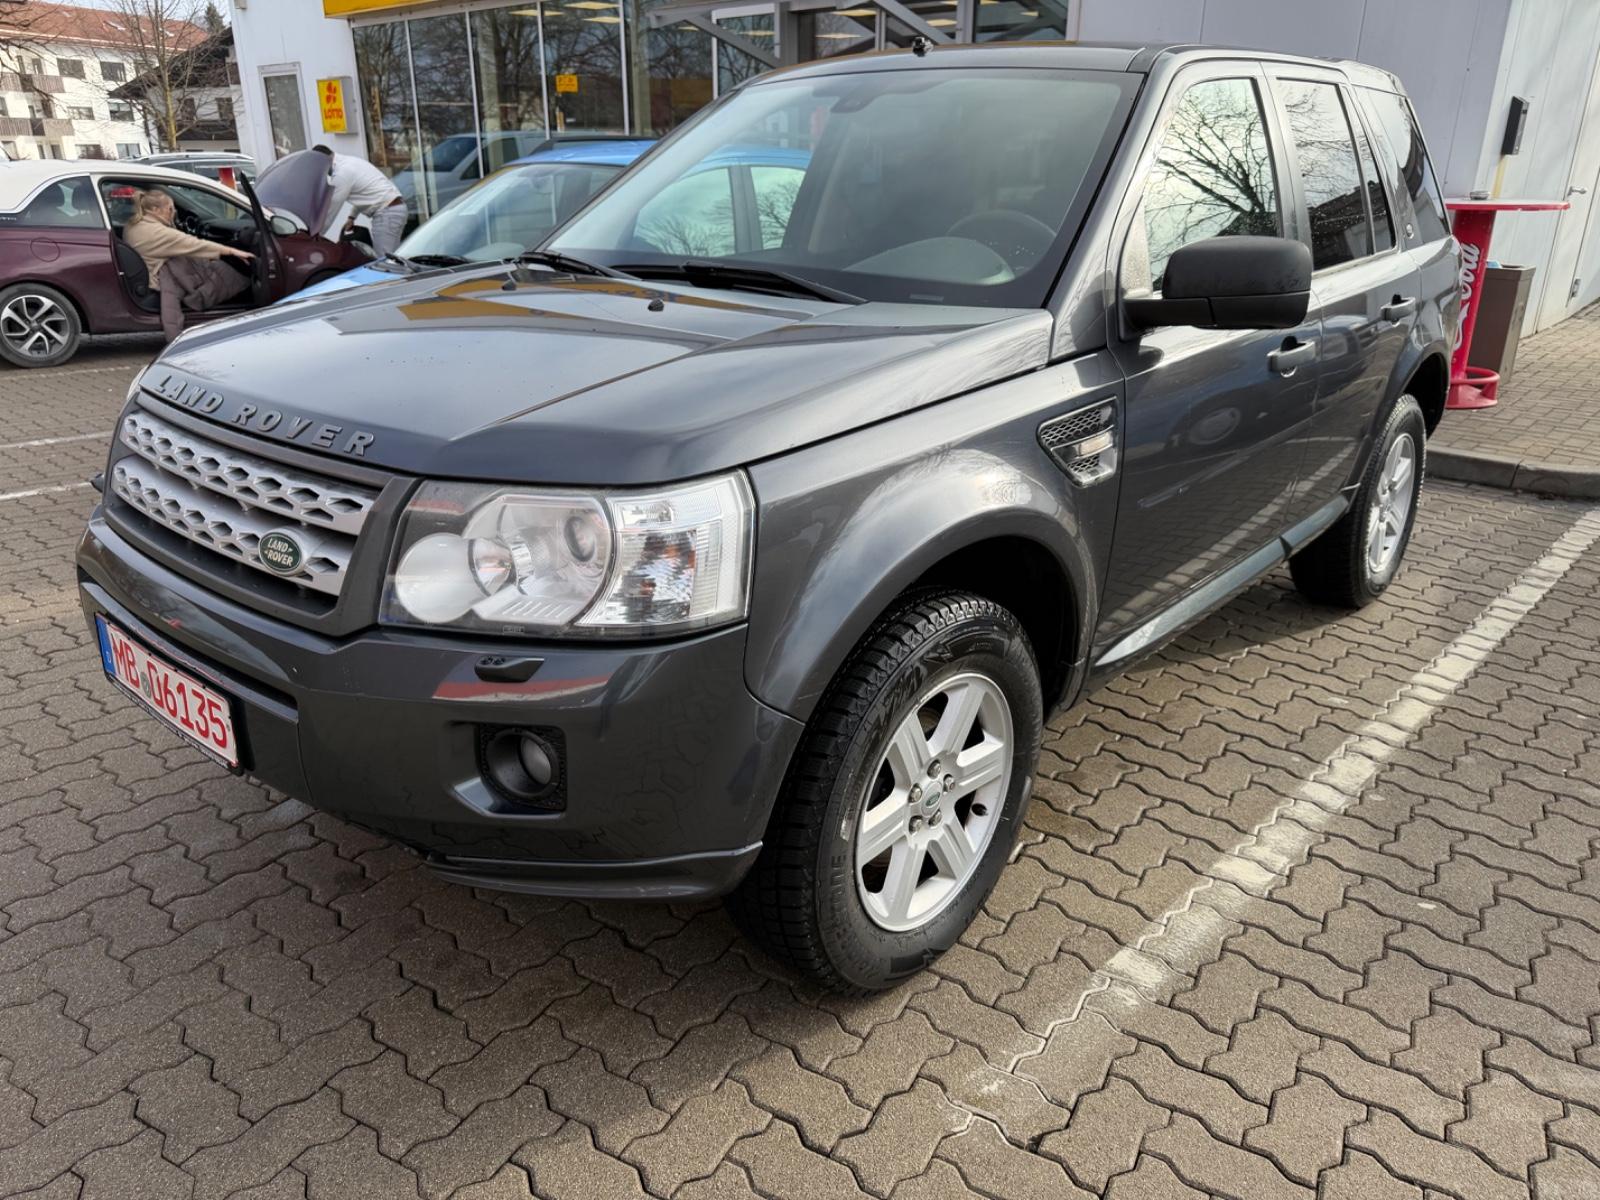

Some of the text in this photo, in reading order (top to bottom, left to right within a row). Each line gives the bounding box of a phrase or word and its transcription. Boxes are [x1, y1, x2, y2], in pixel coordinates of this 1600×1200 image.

[156, 375, 375, 456] LAND ROVER
[267, 537, 289, 552] LAND
[267, 550, 294, 566] ROVER
[111, 634, 140, 689] MB
